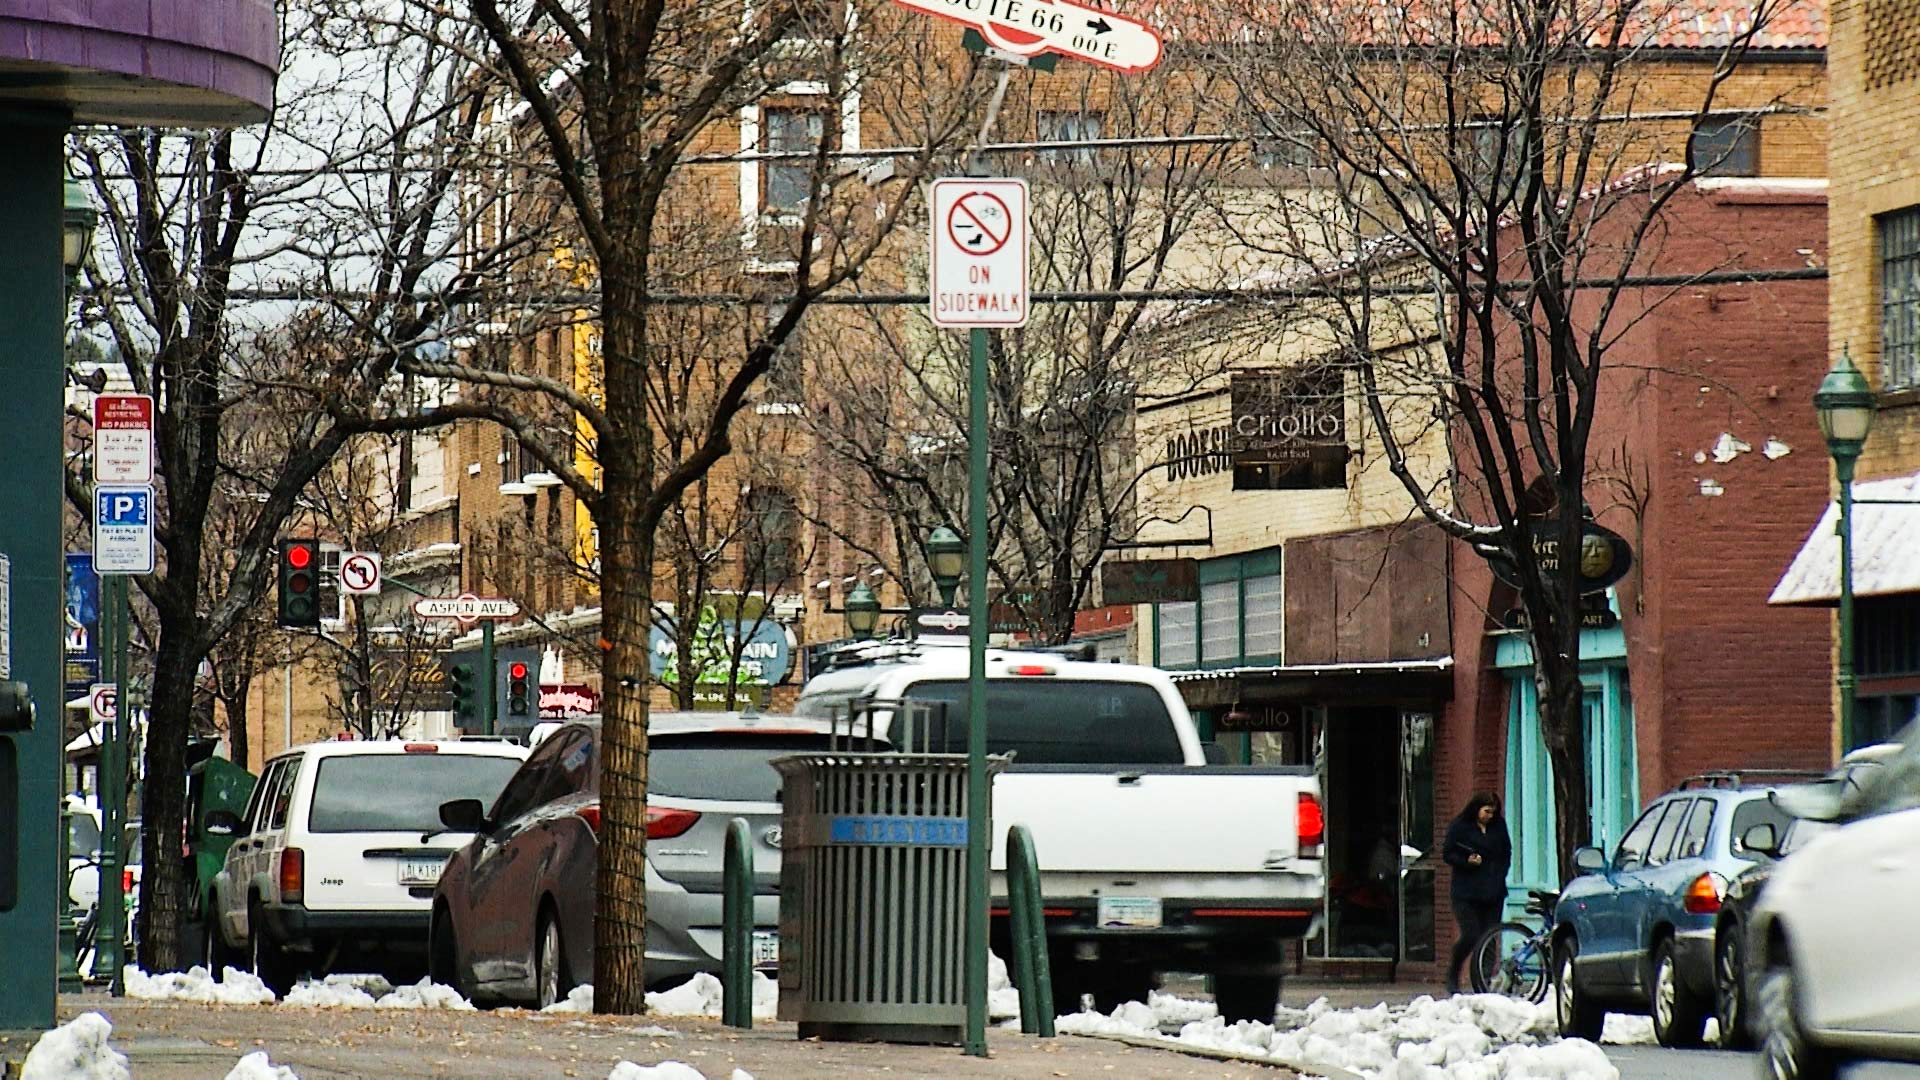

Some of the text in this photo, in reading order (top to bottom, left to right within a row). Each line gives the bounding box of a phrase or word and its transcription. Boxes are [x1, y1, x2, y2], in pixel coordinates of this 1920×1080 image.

[949, 0, 1064, 34] UTE 66
[1072, 34, 1119, 59] 00 E
[969, 265, 990, 285] ON
[940, 293, 1020, 312] SIDEWALK
[1236, 407, 1340, 437] criollo
[114, 496, 134, 521] P
[429, 602, 508, 614] ASPEN AVE
[320, 877, 344, 886] Jeep
